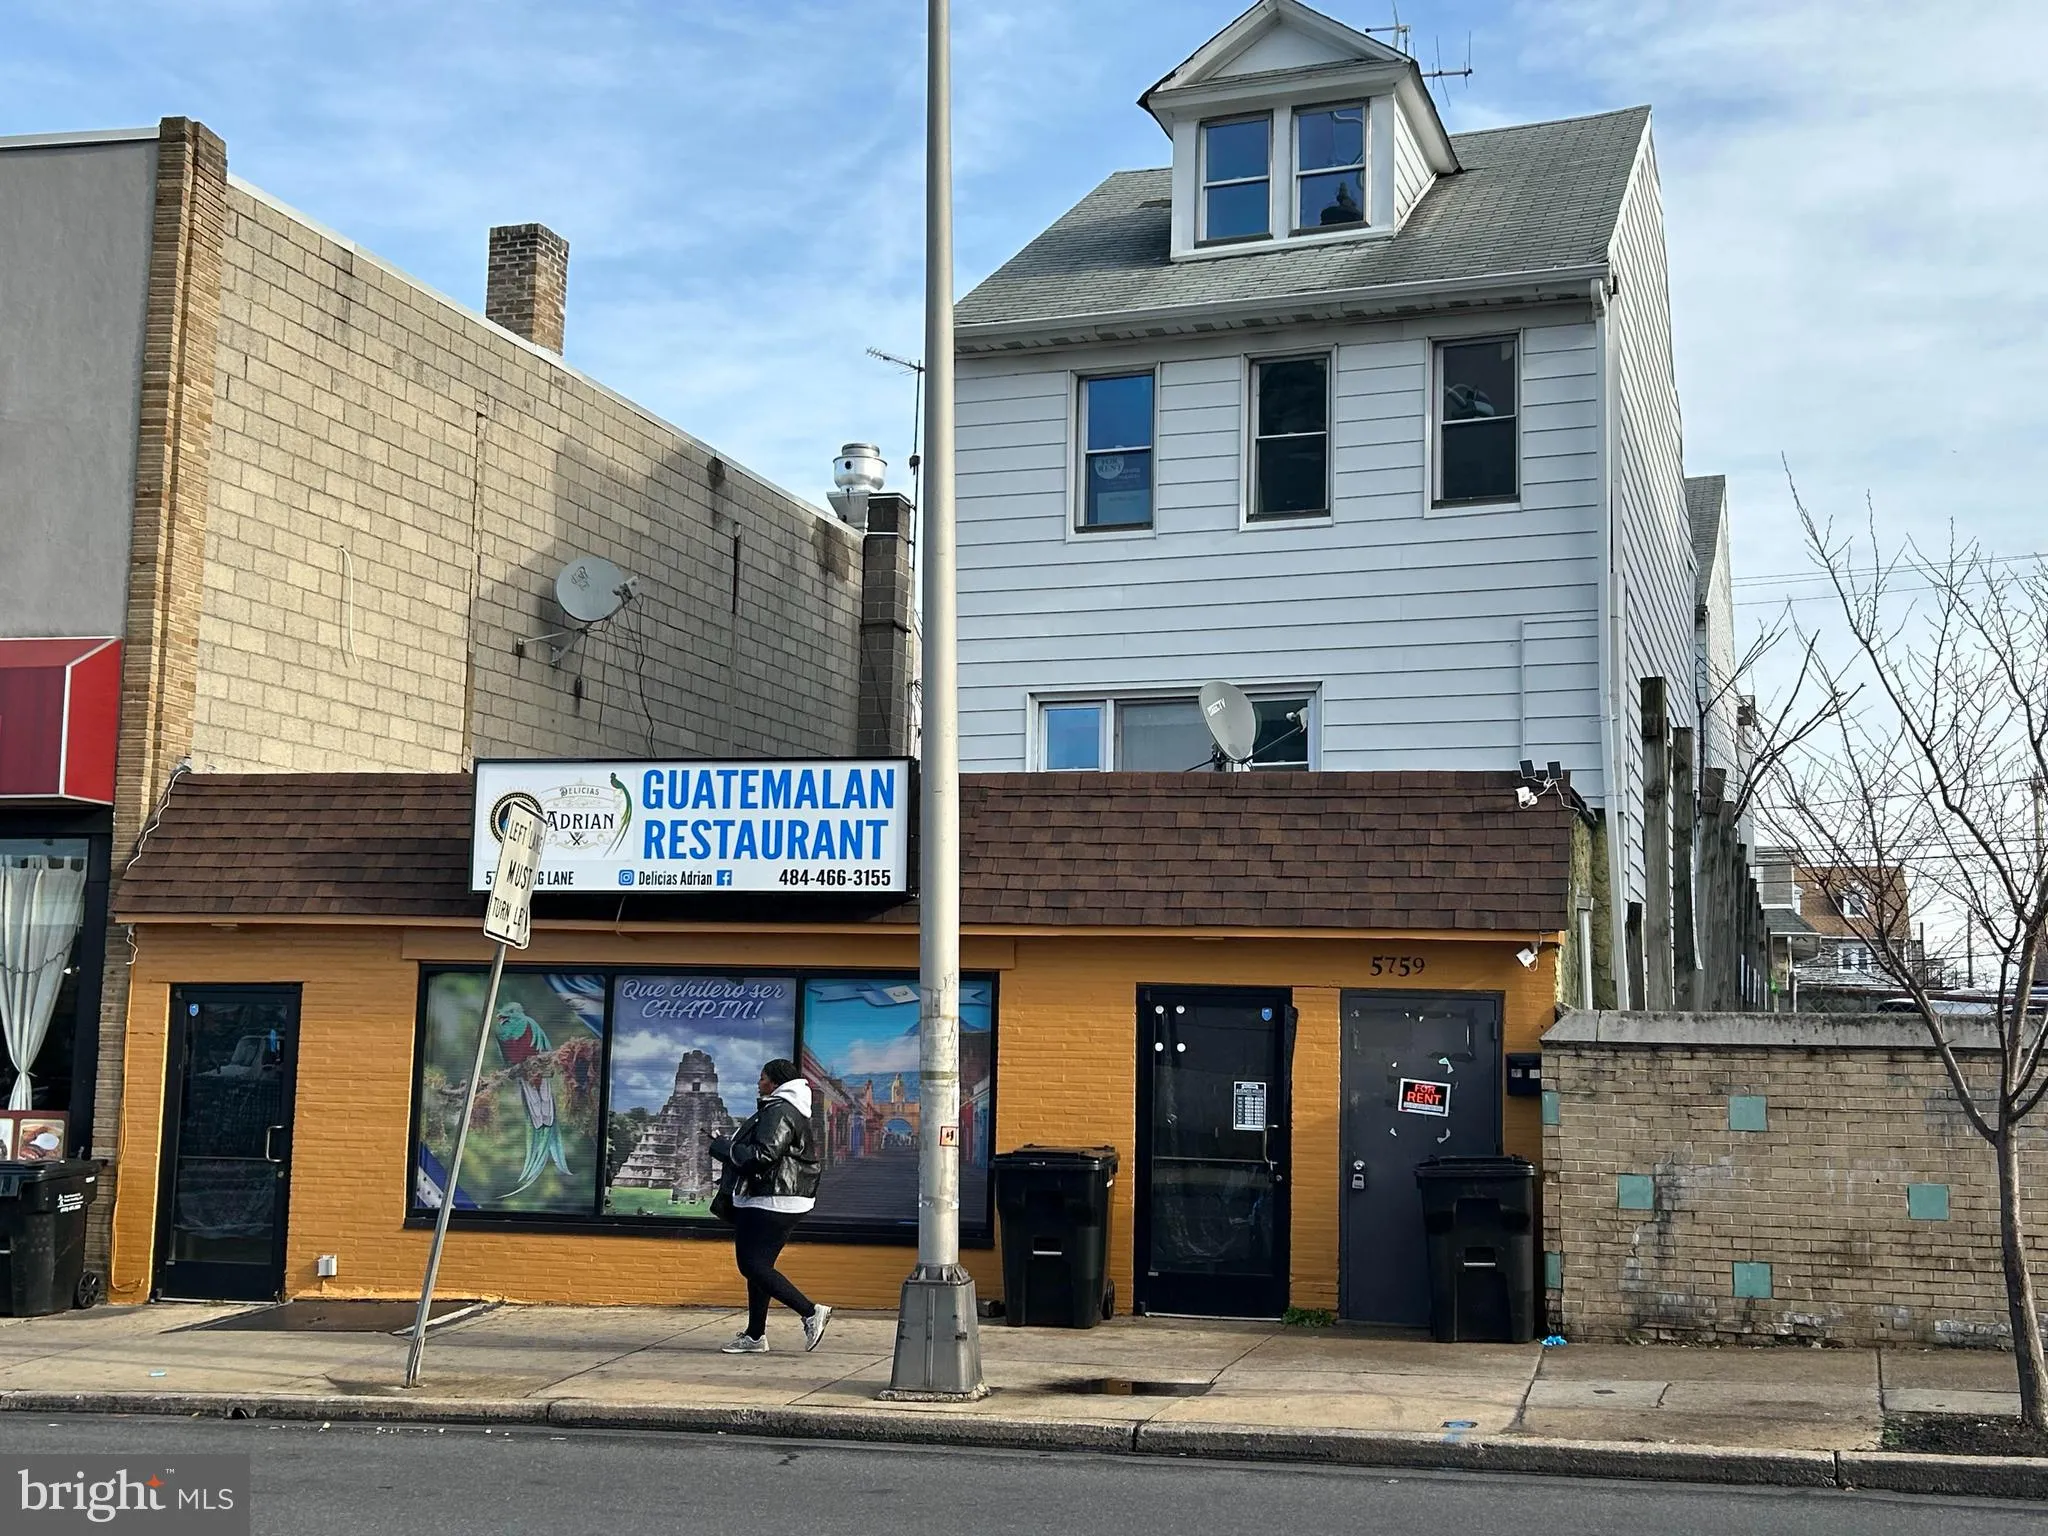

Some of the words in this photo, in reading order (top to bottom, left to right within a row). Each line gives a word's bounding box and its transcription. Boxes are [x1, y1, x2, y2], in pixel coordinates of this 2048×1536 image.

[560, 787, 600, 797] DELICIAS
[642, 768, 895, 810] GUATEMALAN
[546, 810, 615, 832] ADRIAN
[508, 820, 528, 846] LEFT
[643, 819, 889, 860] RESTAURANT
[506, 859, 533, 892] MUST
[547, 871, 575, 886] LANE
[638, 870, 678, 886] Delicias
[680, 870, 713, 886] Adrian
[779, 868, 891, 886] 484-466-3155
[492, 896, 512, 922] TURN
[1369, 955, 1425, 977] 5759
[622, 979, 667, 1000] Que
[670, 979, 747, 999] chilero
[749, 983, 785, 999] ser
[641, 999, 764, 1019] CHAPIN!
[1406, 1091, 1442, 1105] RENT
[1414, 1083, 1436, 1094] FOR
